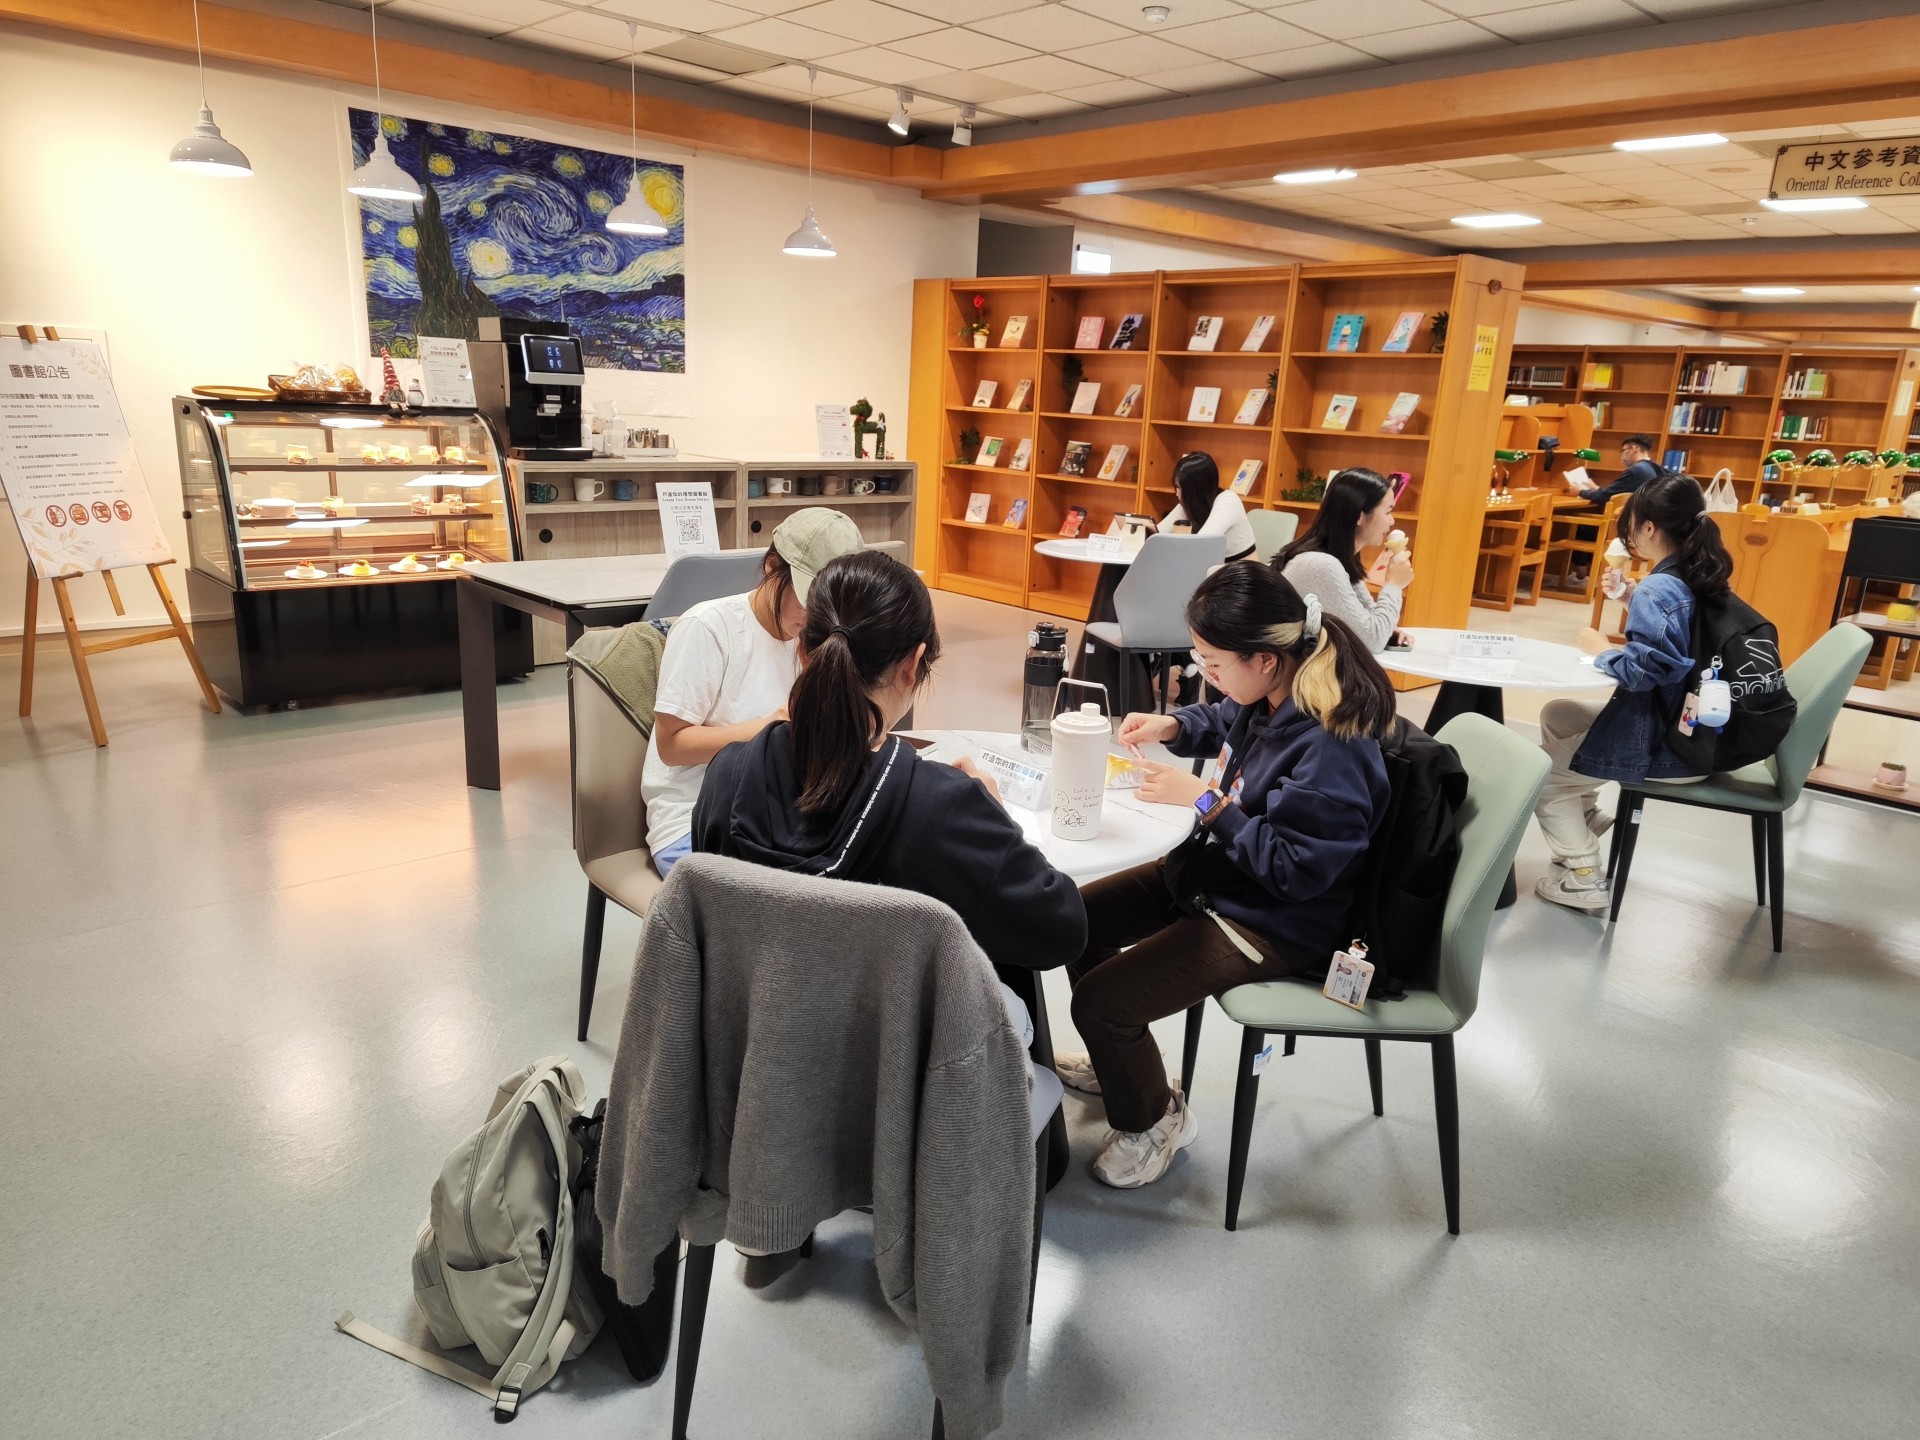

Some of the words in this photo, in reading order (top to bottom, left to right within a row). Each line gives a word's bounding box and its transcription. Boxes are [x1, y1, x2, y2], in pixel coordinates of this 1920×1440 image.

[1805, 145, 1920, 171] 中文參考資
[1786, 176, 1830, 192] Oriental
[1835, 174, 1893, 190] Reference
[9, 364, 70, 379] 圖書館公告
[982, 752, 1044, 781] 打造你的理想圖書館
